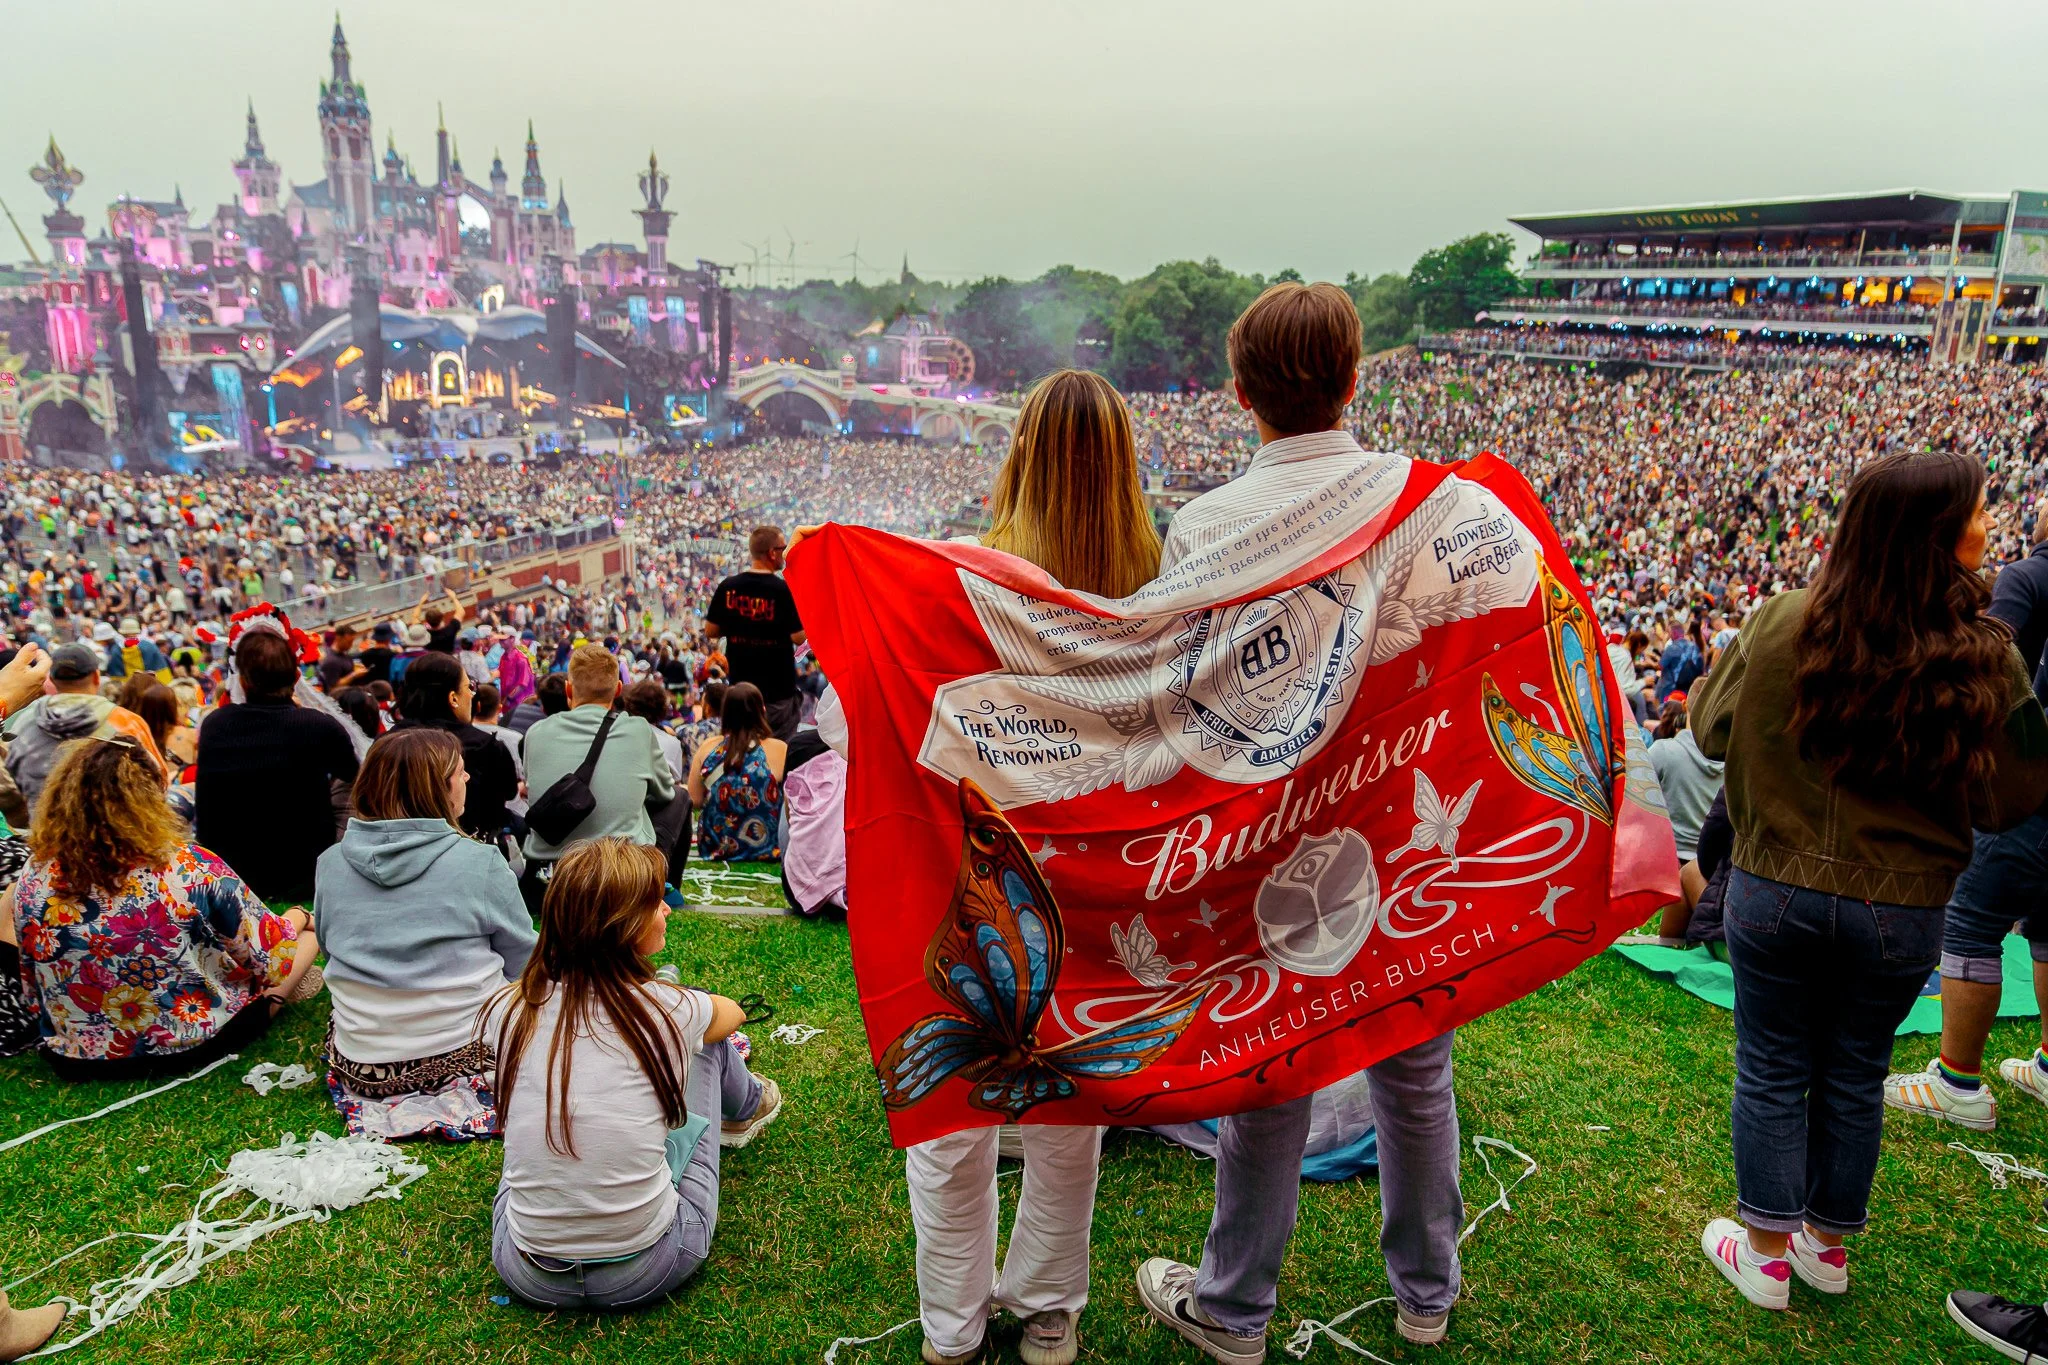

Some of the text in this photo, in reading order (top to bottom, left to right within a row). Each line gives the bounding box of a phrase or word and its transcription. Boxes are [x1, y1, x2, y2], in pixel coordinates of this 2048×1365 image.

[1432, 518, 1508, 563] BUDWEISER
[1047, 641, 1079, 657] crisp
[1082, 634, 1105, 647] and
[1106, 618, 1149, 640] unique
[1187, 616, 1211, 668] AUSTRALIA
[1324, 646, 1342, 686] ASIA
[1255, 677, 1292, 703] TRADE MARK
[953, 714, 1078, 744] THE WORLD
[1200, 709, 1236, 738] AFRICA
[975, 740, 1082, 769] RENOWNED
[1259, 727, 1318, 763] AMERICA
[1121, 709, 1453, 901] Budweiser
[1199, 923, 1497, 1072] ANHEUSER-BUSCH
